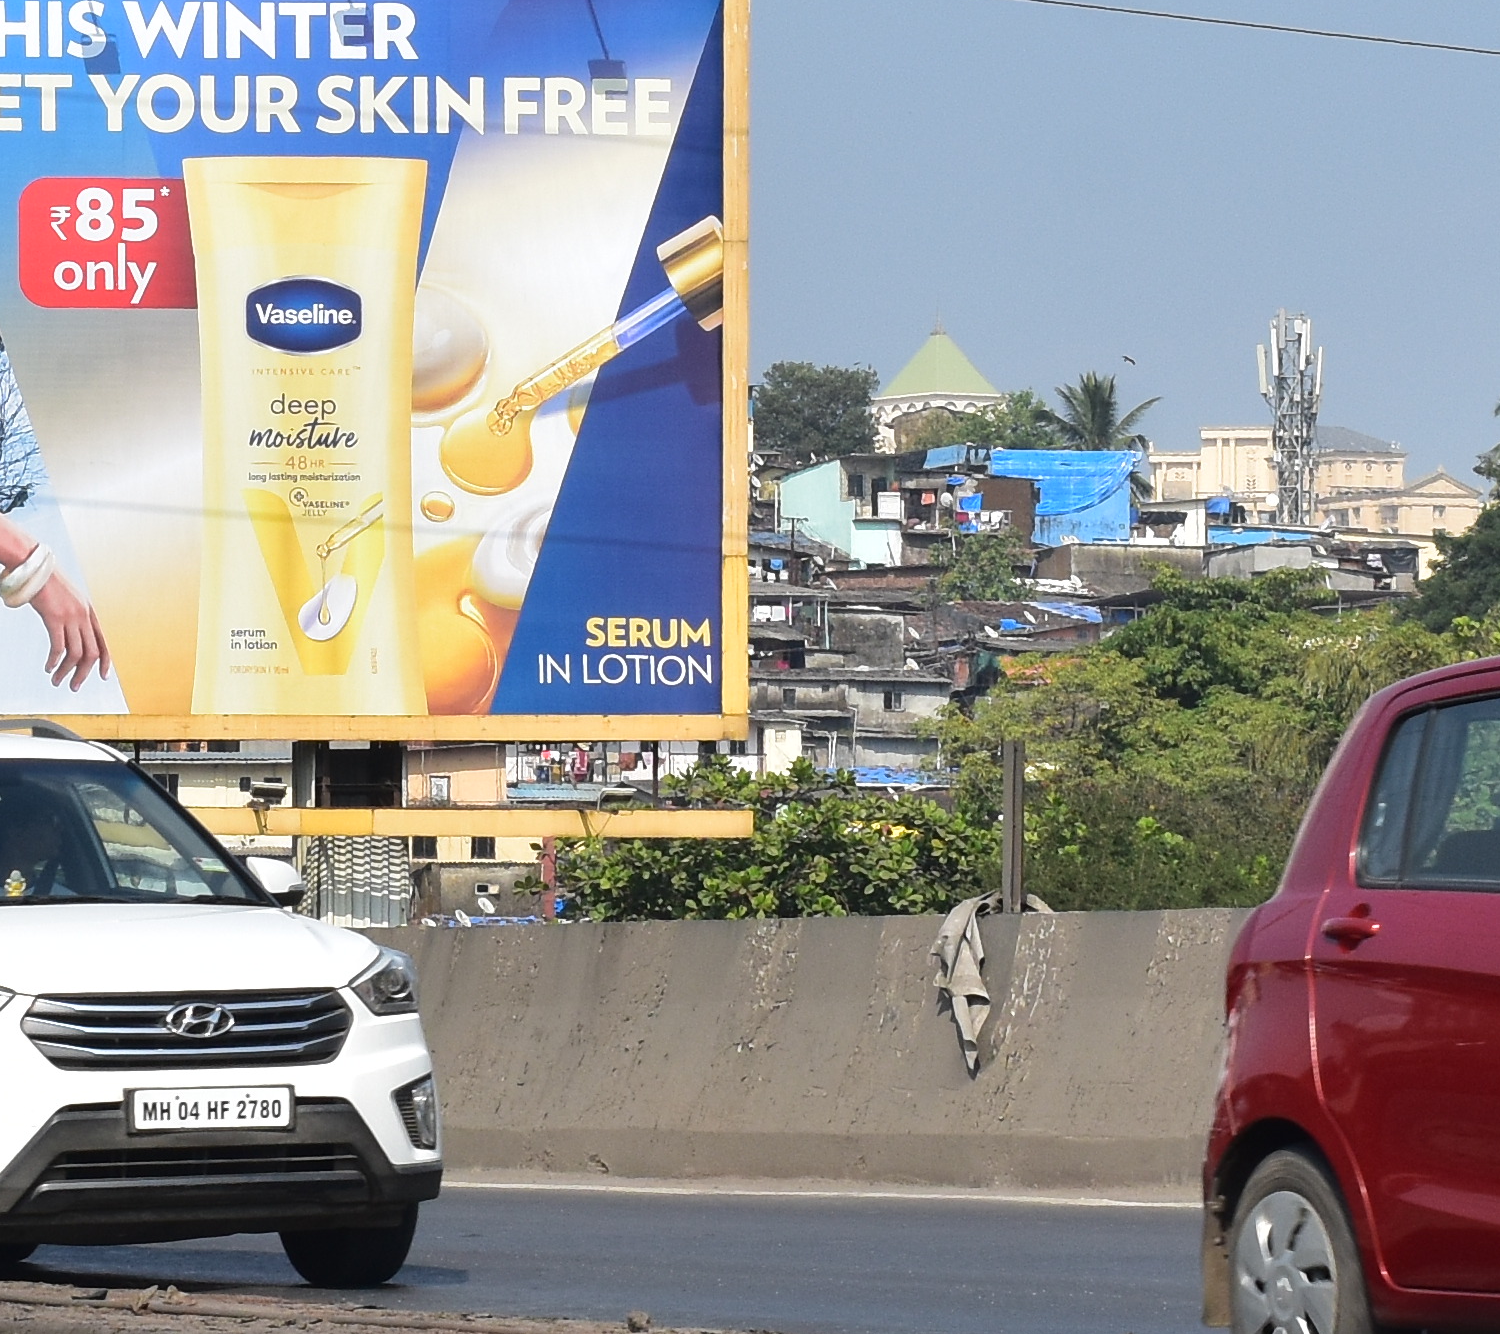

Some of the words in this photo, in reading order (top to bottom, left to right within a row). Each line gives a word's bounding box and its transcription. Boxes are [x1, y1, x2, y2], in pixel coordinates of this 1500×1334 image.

[121, 1, 419, 61] WINTER
[91, 74, 304, 136] YOUR
[316, 76, 486, 137] SKIN
[504, 78, 673, 137] FREE
[53, 242, 157, 304] only
[251, 368, 315, 376] INTENSIVE
[270, 392, 337, 419] deep
[249, 417, 359, 449] moisture
[285, 455, 307, 470] 48
[310, 459, 325, 468] HR
[248, 472, 267, 483] long
[268, 472, 298, 483] lasting
[299, 472, 361, 482] moisturization
[230, 628, 266, 638] serum
[230, 639, 241, 649] in
[244, 639, 278, 650] lotion
[586, 616, 712, 649] SERUM
[538, 655, 573, 685] IN
[583, 655, 713, 687] LOTION
[143, 1101, 171, 1120] MH
[178, 1101, 200, 1120] 04
[208, 1100, 230, 1119] HF
[237, 1099, 282, 1119] 2780
